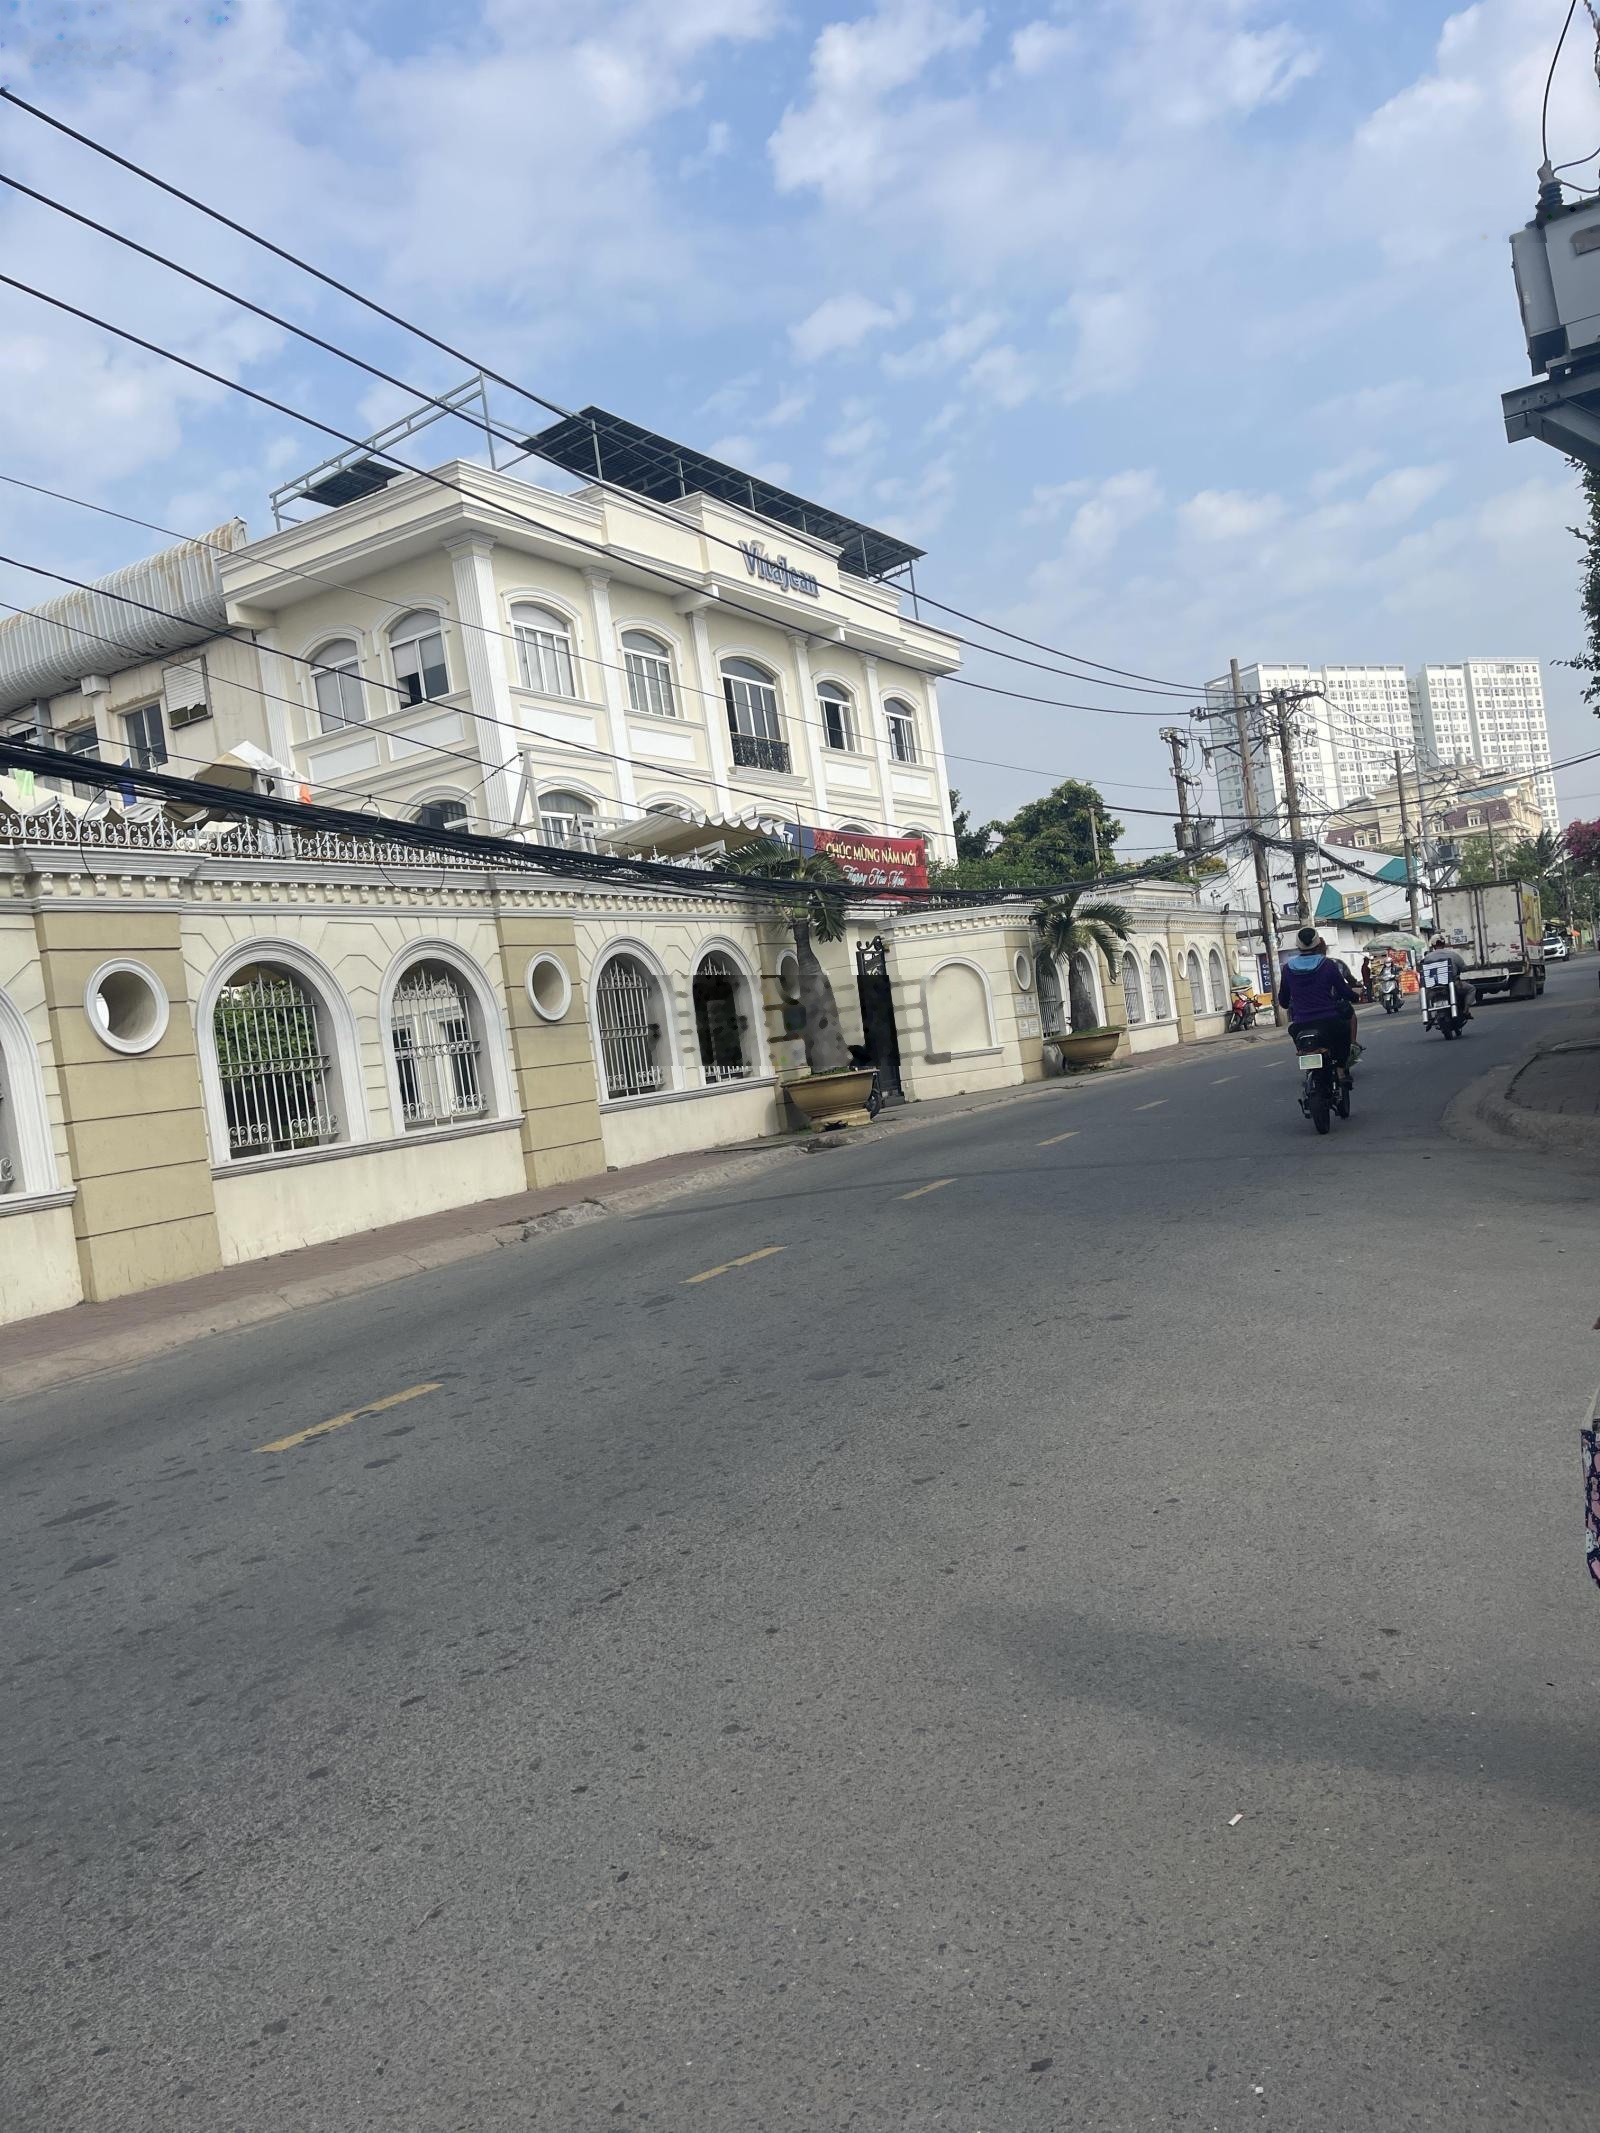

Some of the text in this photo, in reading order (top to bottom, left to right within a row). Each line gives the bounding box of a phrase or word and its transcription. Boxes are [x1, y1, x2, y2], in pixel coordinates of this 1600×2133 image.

[826, 842, 917, 867] CHÚC MỪNG NĂM MỚI
